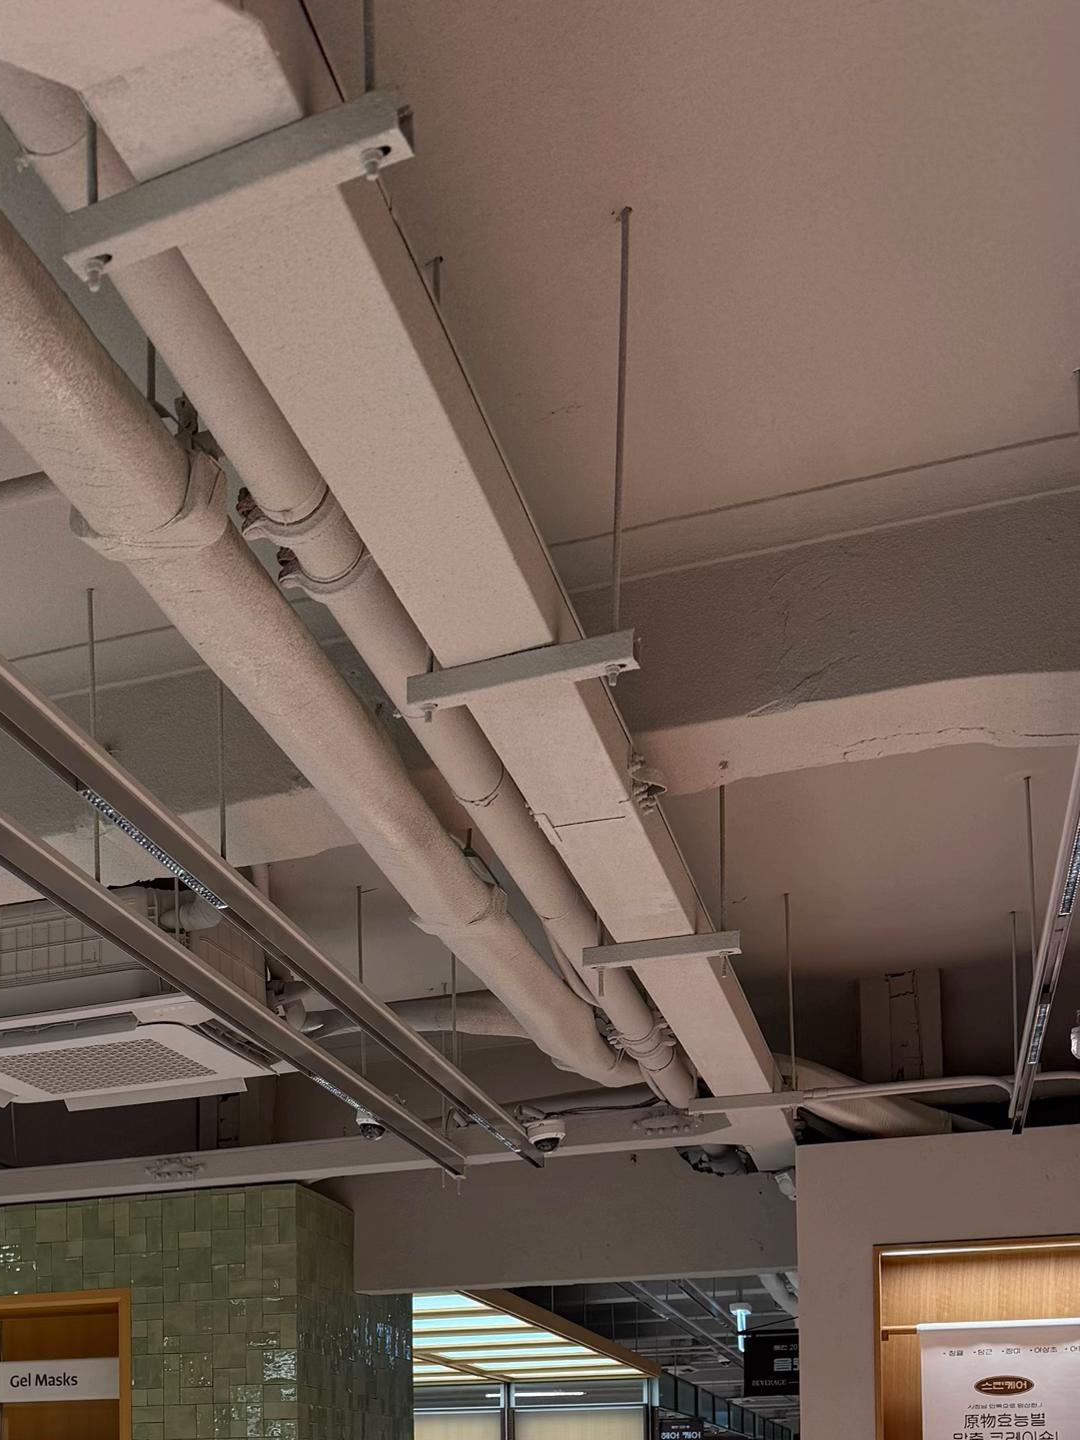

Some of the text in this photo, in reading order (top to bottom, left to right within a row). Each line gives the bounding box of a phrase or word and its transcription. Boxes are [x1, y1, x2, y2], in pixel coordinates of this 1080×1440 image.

[10, 1372, 78, 1388] Gel Masks
[981, 1380, 1028, 1390] 스킨케어
[964, 1412, 1046, 1429] 原物효능별
